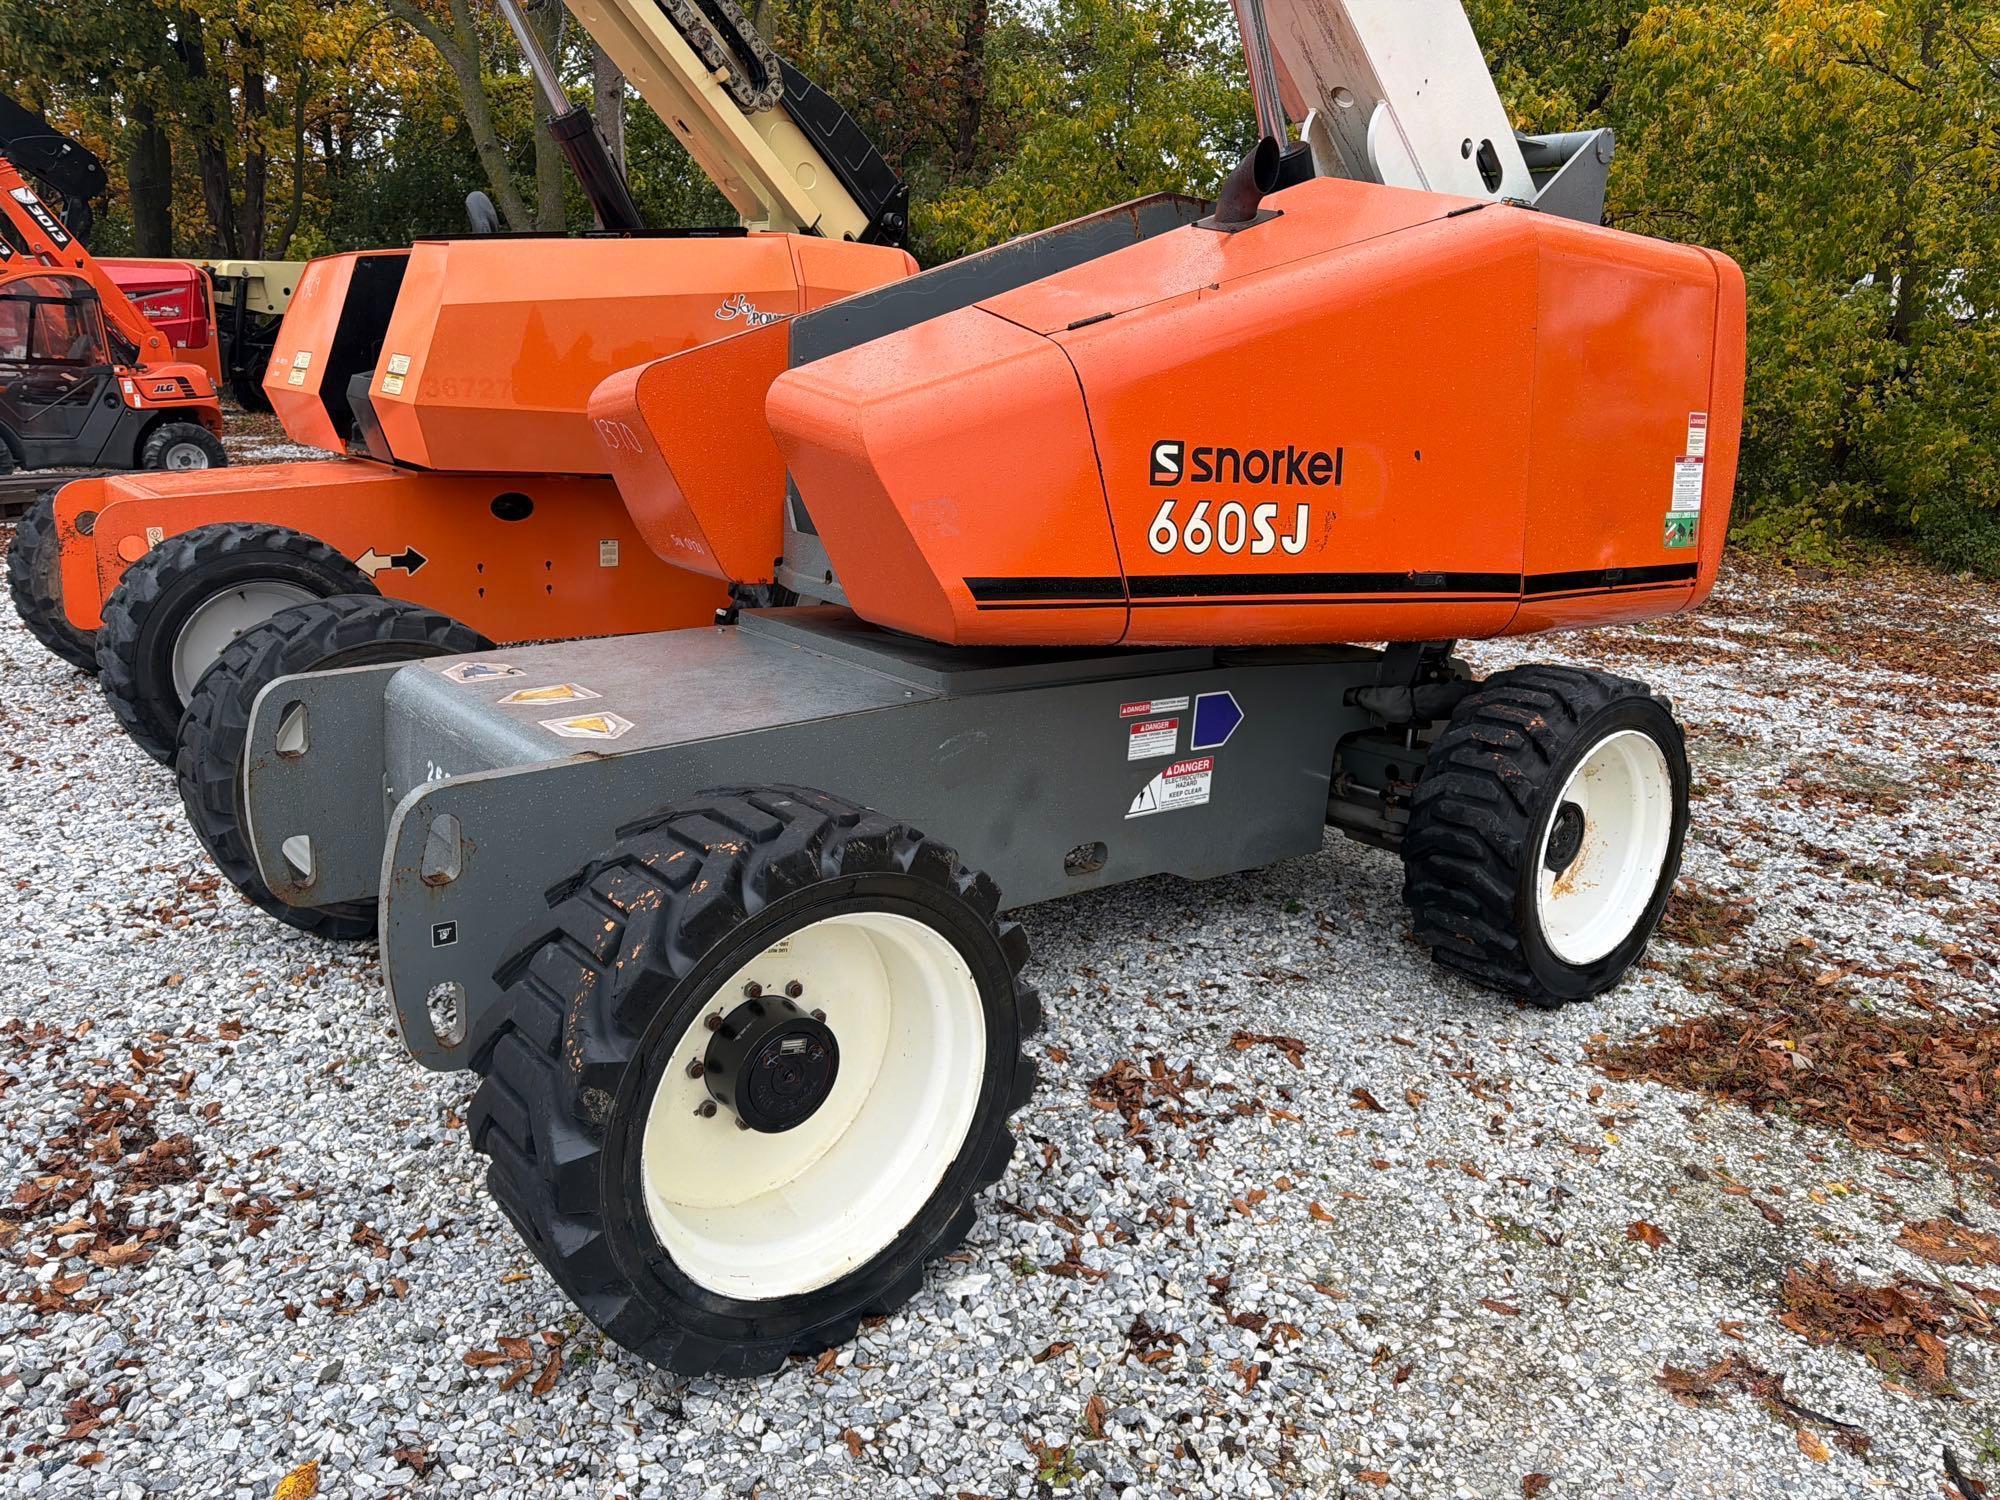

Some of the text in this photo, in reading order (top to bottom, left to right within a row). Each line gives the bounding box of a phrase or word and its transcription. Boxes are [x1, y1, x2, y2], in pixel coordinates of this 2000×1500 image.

[28, 205, 68, 242] 3013
[154, 384, 174, 392] JLG
[1191, 445, 1344, 486] snorkel
[1148, 499, 1310, 555] 660SJ
[1127, 704, 1150, 713] DANGER
[1145, 721, 1169, 731] DANGER
[1173, 759, 1210, 775] DANGER
[1164, 772, 1209, 785] ELECTROCUTION
[1175, 780, 1198, 789] HAZARD
[1168, 787, 1202, 799] KEEP CLEAR
